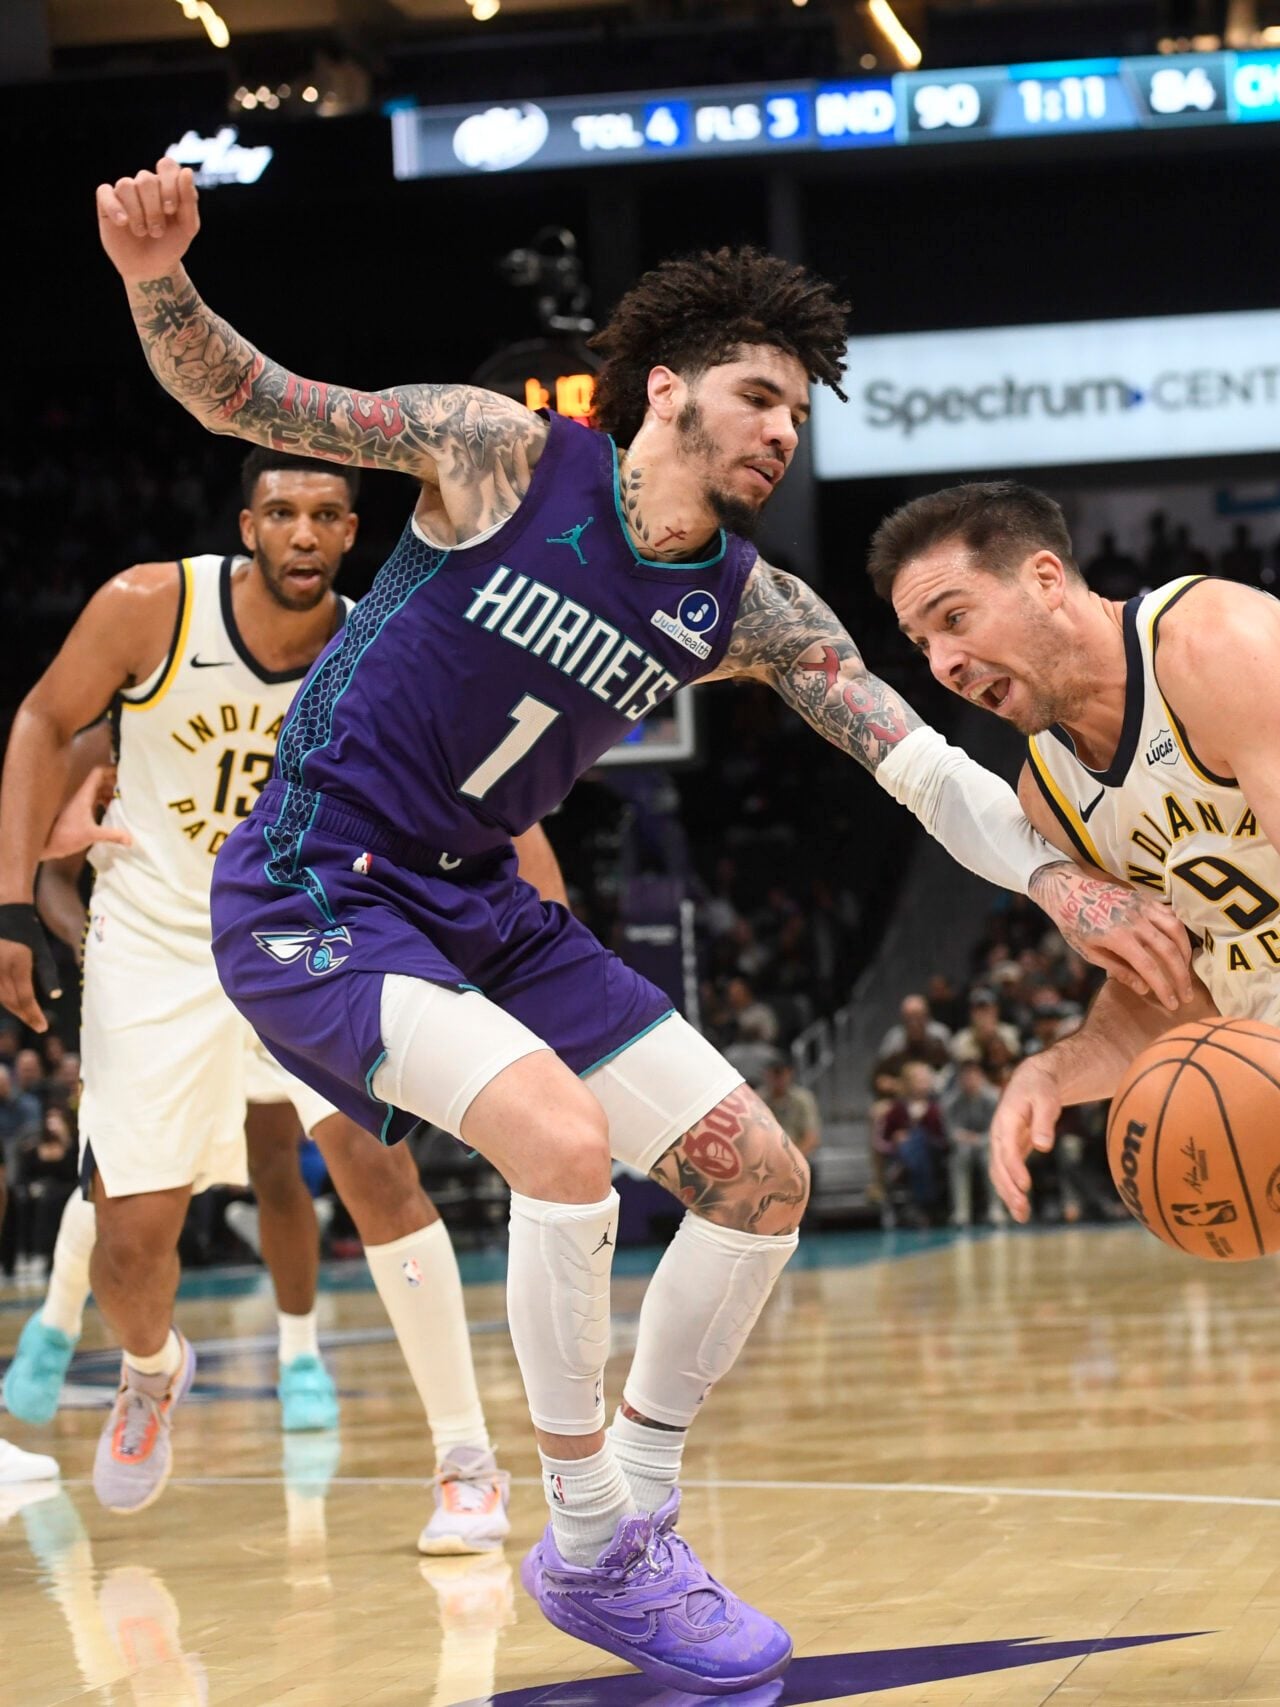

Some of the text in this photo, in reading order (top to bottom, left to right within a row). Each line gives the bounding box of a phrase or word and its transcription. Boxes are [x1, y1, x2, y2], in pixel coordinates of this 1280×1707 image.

[644, 107, 679, 147] 4
[697, 103, 760, 142] FLS
[768, 98, 799, 139] 3
[816, 91, 895, 136] IND
[914, 83, 979, 128] 90
[1018, 76, 1106, 122] 1:11
[1150, 68, 1217, 112] 84
[864, 376, 1126, 438] Spectrum
[463, 563, 681, 722] HORNETS
[653, 615, 709, 658] Judi Health
[172, 704, 285, 752] INDIA
[458, 692, 563, 800] 1
[1146, 737, 1174, 766] LUCAS
[214, 748, 275, 817] 13
[168, 797, 228, 856] PAC
[1125, 791, 1259, 896] NDIANA
